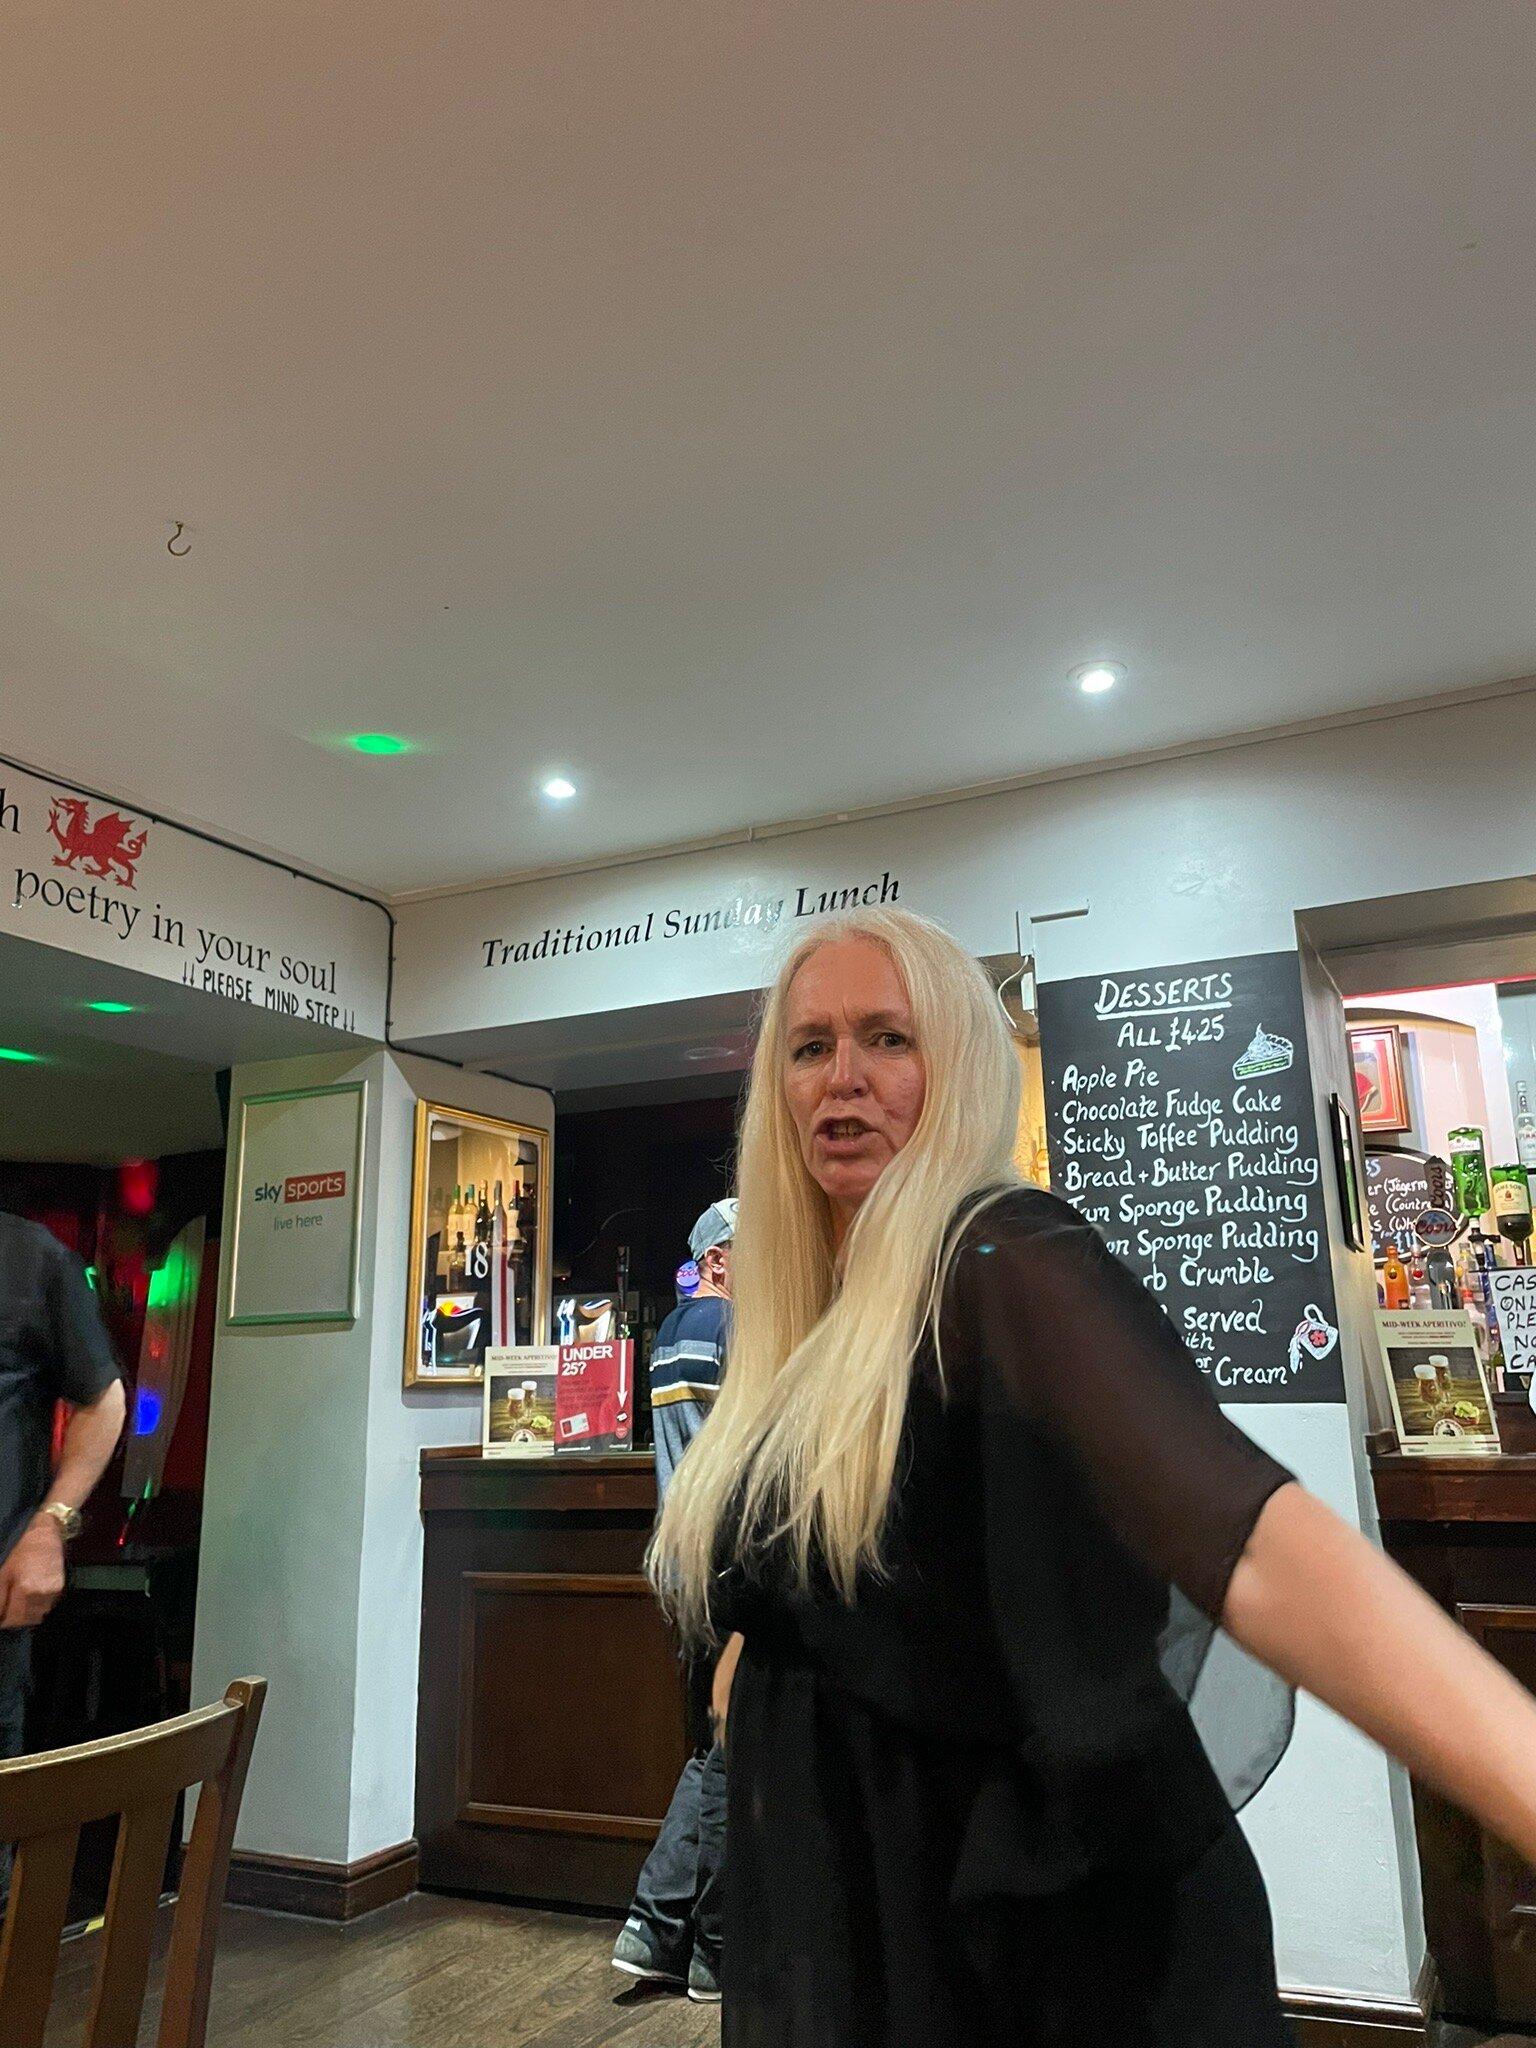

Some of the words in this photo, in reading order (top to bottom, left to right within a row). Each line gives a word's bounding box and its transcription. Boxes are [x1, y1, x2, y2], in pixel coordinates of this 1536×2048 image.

[0, 788, 20, 834] h
[13, 868, 140, 940] poetry
[152, 903, 185, 948] in
[195, 928, 271, 973] your
[279, 955, 337, 995] soul
[482, 912, 654, 968] Traditional
[663, 897, 783, 939] Sunday
[794, 871, 900, 918] Lunch
[203, 968, 253, 1003] PLEASE
[265, 986, 299, 1016] MIND
[306, 998, 339, 1028] STEP
[1094, 972, 1233, 1013] DESSERTS
[1117, 1021, 1161, 1048] ALL
[1062, 1064, 1117, 1095] Apple
[1124, 1058, 1160, 1087] Pie
[1062, 1094, 1159, 1124] Chocolate
[1165, 1088, 1223, 1128] Fudge
[1232, 1085, 1282, 1114] Cake
[1063, 1127, 1126, 1161] Sticky
[1136, 1122, 1198, 1154] Toffee
[1210, 1118, 1298, 1154] Pudding
[1065, 1160, 1136, 1191] Bread
[1138, 1170, 1149, 1183] +
[1151, 1157, 1221, 1187] Butter
[1227, 1152, 1319, 1186] Pudding
[255, 1182, 283, 1204] sky
[286, 1176, 343, 1200] sports
[1119, 1193, 1199, 1227] Sponge
[1204, 1185, 1308, 1222] Pudding
[274, 1215, 294, 1231] live
[296, 1213, 323, 1228] here
[1106, 1239, 1130, 1255] on
[1137, 1229, 1213, 1262] Sponge
[1221, 1221, 1319, 1262] Pudding
[1143, 1262, 1167, 1291] rb
[1180, 1256, 1274, 1287] Crumble
[1495, 1274, 1536, 1292] CAS
[1183, 1298, 1267, 1334] Served
[1500, 1296, 1536, 1312] ONL
[1507, 1311, 1536, 1330] PLE
[1182, 1332, 1215, 1351] ith
[1382, 1320, 1421, 1329] MID-WEEK
[561, 1361, 588, 1377] 25?
[562, 1344, 613, 1362] UNDER
[1510, 1353, 1536, 1370] CA
[1195, 1356, 1213, 1374] or
[1215, 1356, 1288, 1387] Cream
